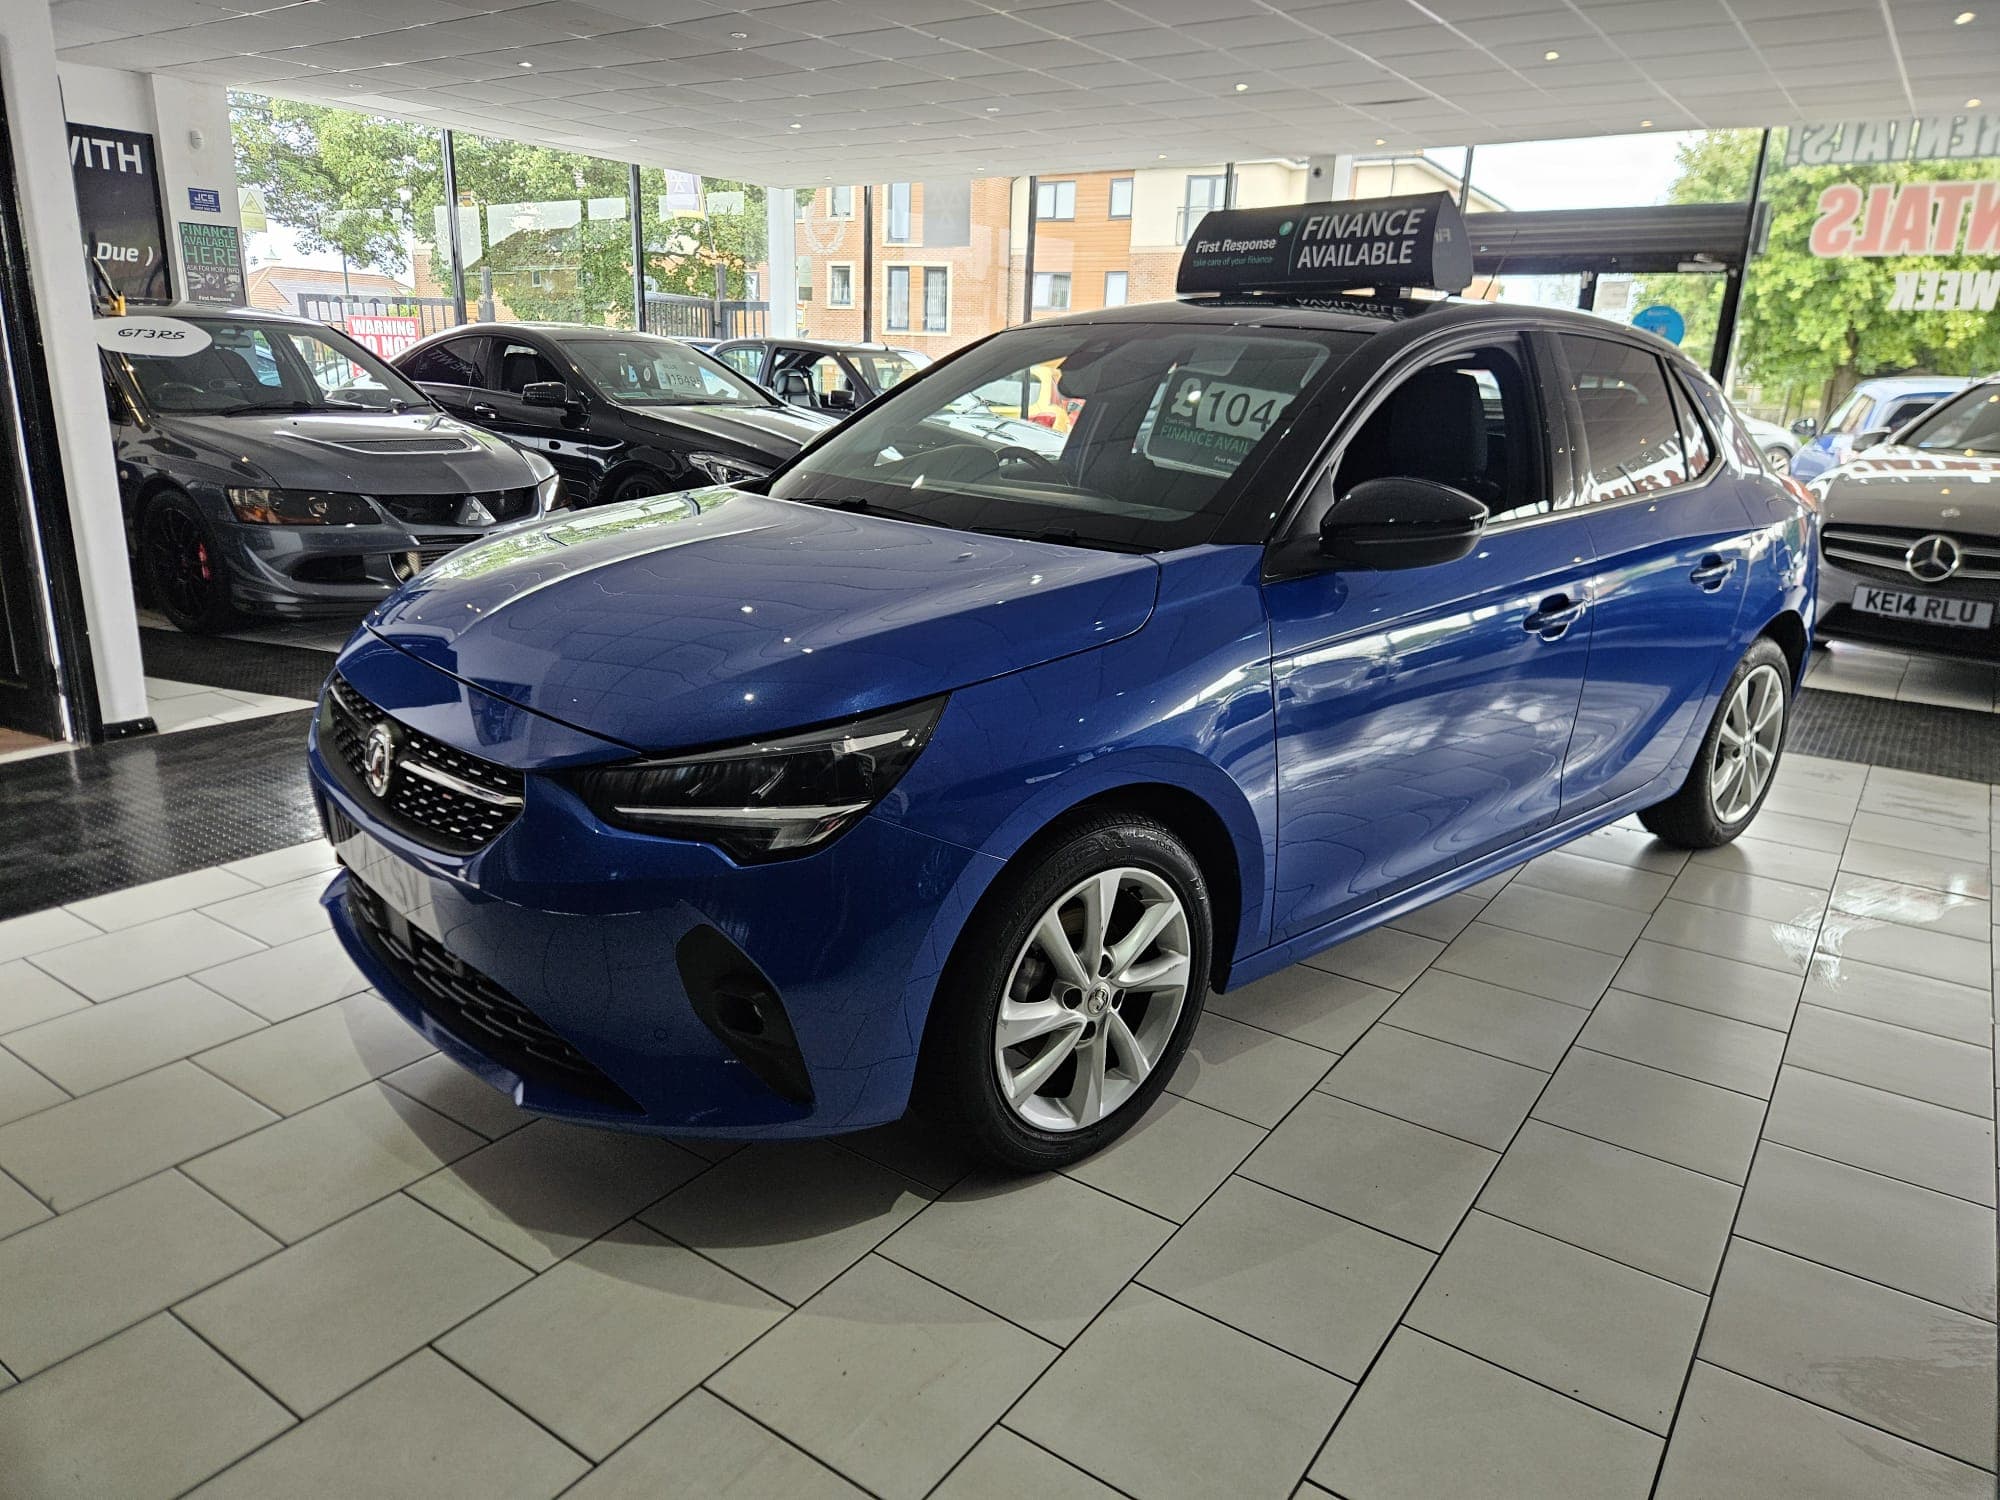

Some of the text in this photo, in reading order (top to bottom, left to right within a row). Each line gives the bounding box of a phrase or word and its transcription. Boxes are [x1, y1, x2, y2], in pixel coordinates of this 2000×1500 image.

[194, 193, 214, 203] JCS
[181, 224, 235, 239] FINANCE
[1302, 208, 1427, 241] FINANCE
[183, 236, 237, 249] AVAILABLE
[1195, 238, 1277, 254] First Response
[97, 242, 139, 263] Due
[184, 246, 239, 267] HERE
[1297, 240, 1415, 269] AVAILABLE
[117, 328, 187, 341] GT3RS
[351, 319, 416, 336] WARNING
[1160, 424, 1214, 447] FINANCE
[1865, 590, 1977, 623] KE14 RLU
